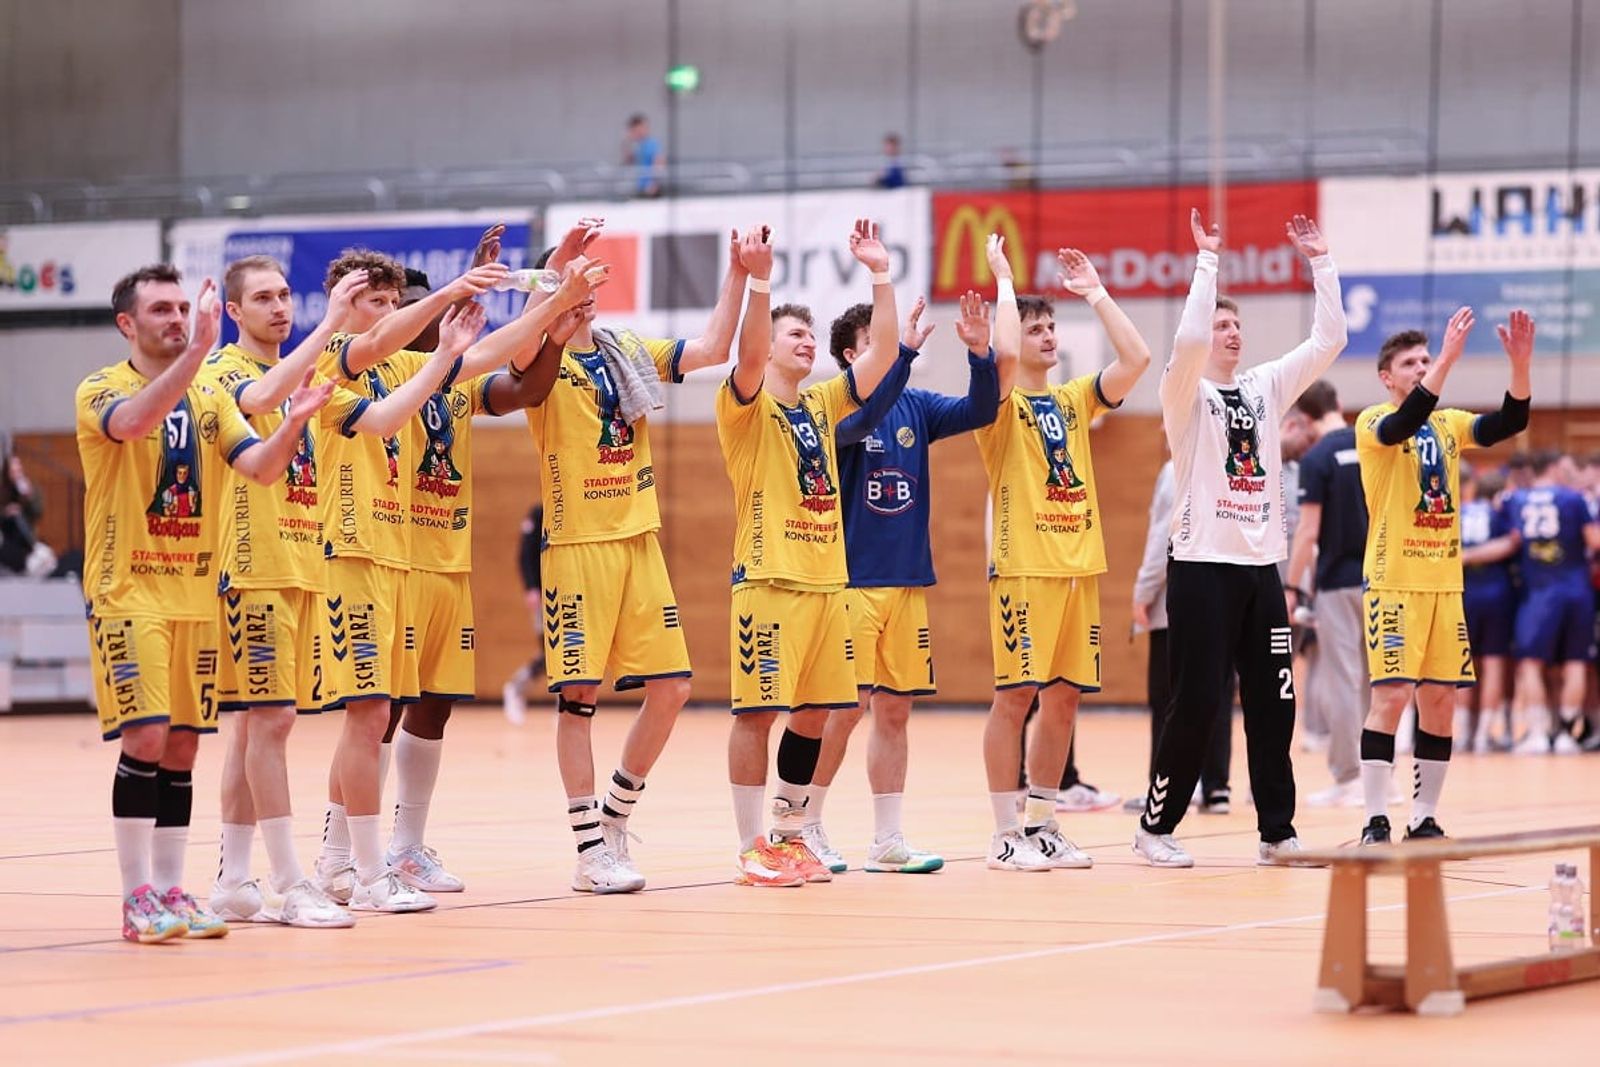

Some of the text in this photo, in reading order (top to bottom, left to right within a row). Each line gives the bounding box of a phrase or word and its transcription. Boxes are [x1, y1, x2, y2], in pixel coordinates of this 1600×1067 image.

[1431, 184, 1600, 236] WAH
[165, 410, 189, 449] 57
[792, 422, 818, 450] 13
[1037, 412, 1063, 440] 19
[234, 483, 253, 575] SÜDKURIER
[340, 463, 357, 544] SÜDKURIER
[1216, 510, 1256, 524] KONTANZ
[246, 612, 276, 695] SCHWARZ
[348, 612, 379, 690] SCHWARZ
[562, 601, 586, 676] SCHWARZ
[756, 630, 780, 701] SCHWARZ
[1383, 610, 1405, 673] SCHWARZ
[107, 629, 140, 716] SCHWARZ
[200, 683, 218, 721] 5
[1278, 667, 1294, 699] 2
